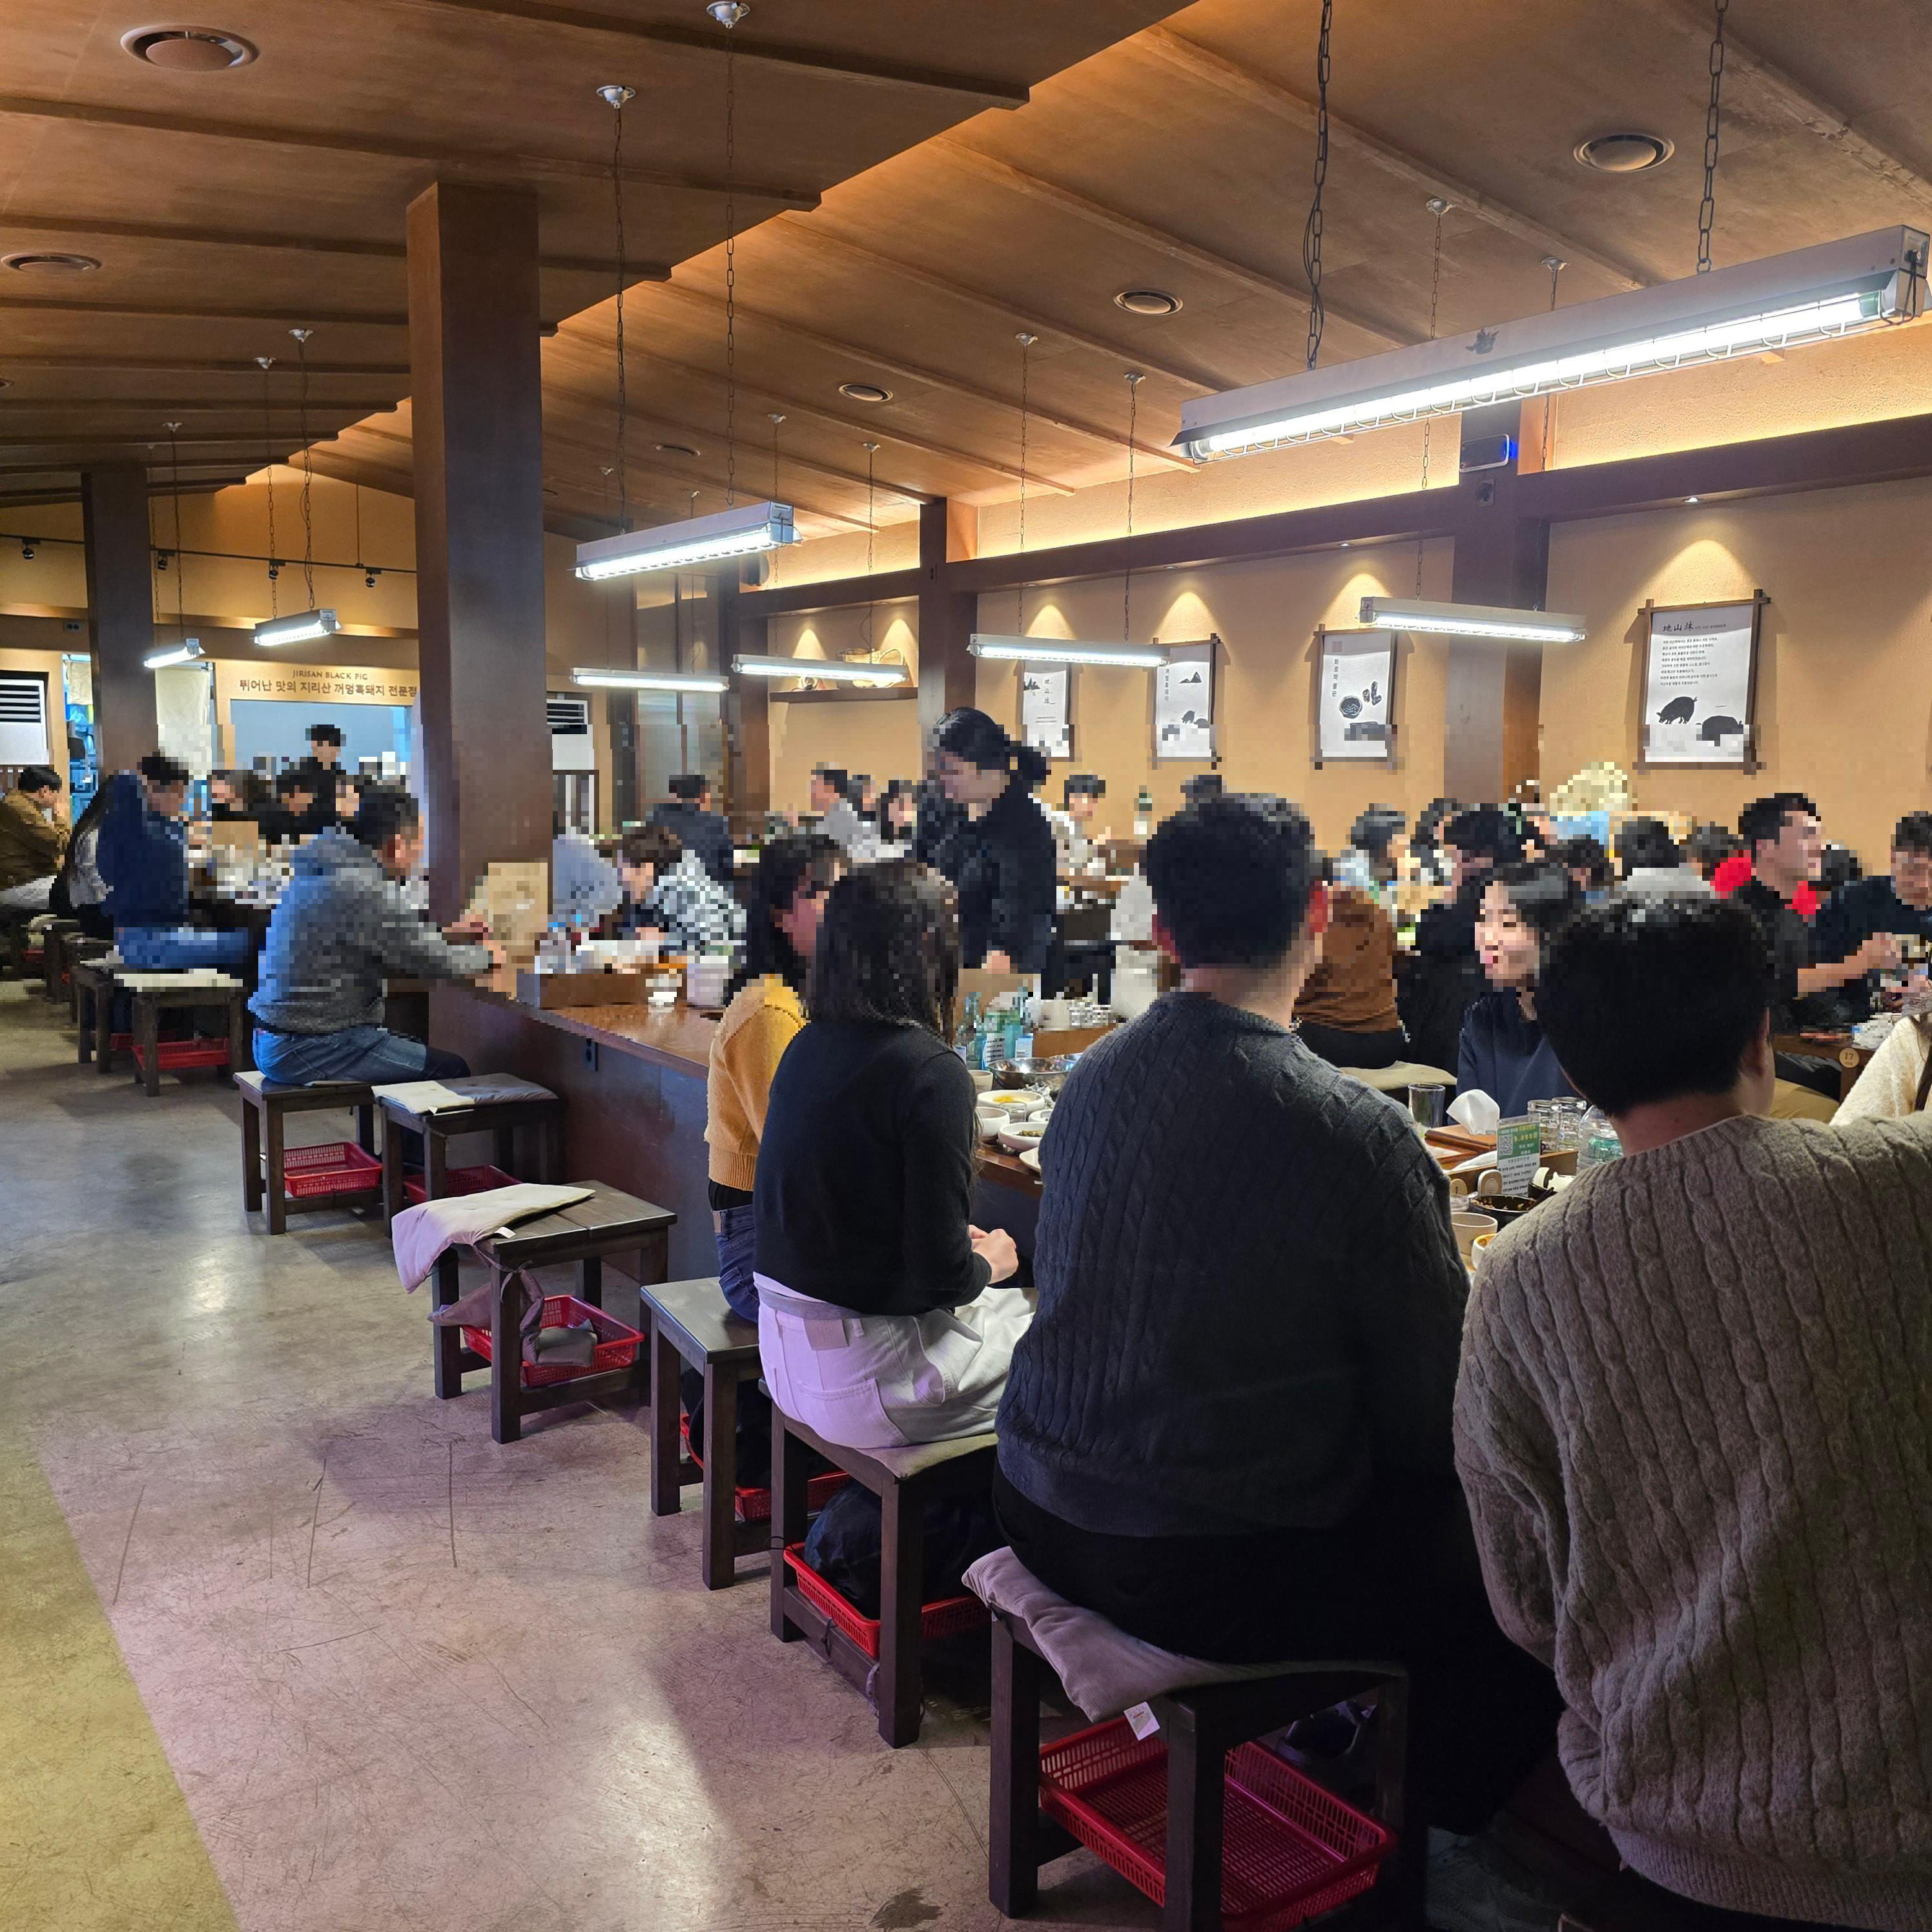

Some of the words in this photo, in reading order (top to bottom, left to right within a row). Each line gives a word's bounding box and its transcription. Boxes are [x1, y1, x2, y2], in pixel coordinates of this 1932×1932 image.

[293, 670, 323, 678] JIRISAN
[240, 679, 272, 692] 뛰어난
[276, 681, 296, 692] 맛의
[300, 682, 331, 694] 지리산
[334, 683, 385, 696] 꺼멍흑돼지
[388, 685, 417, 697] 전문점
